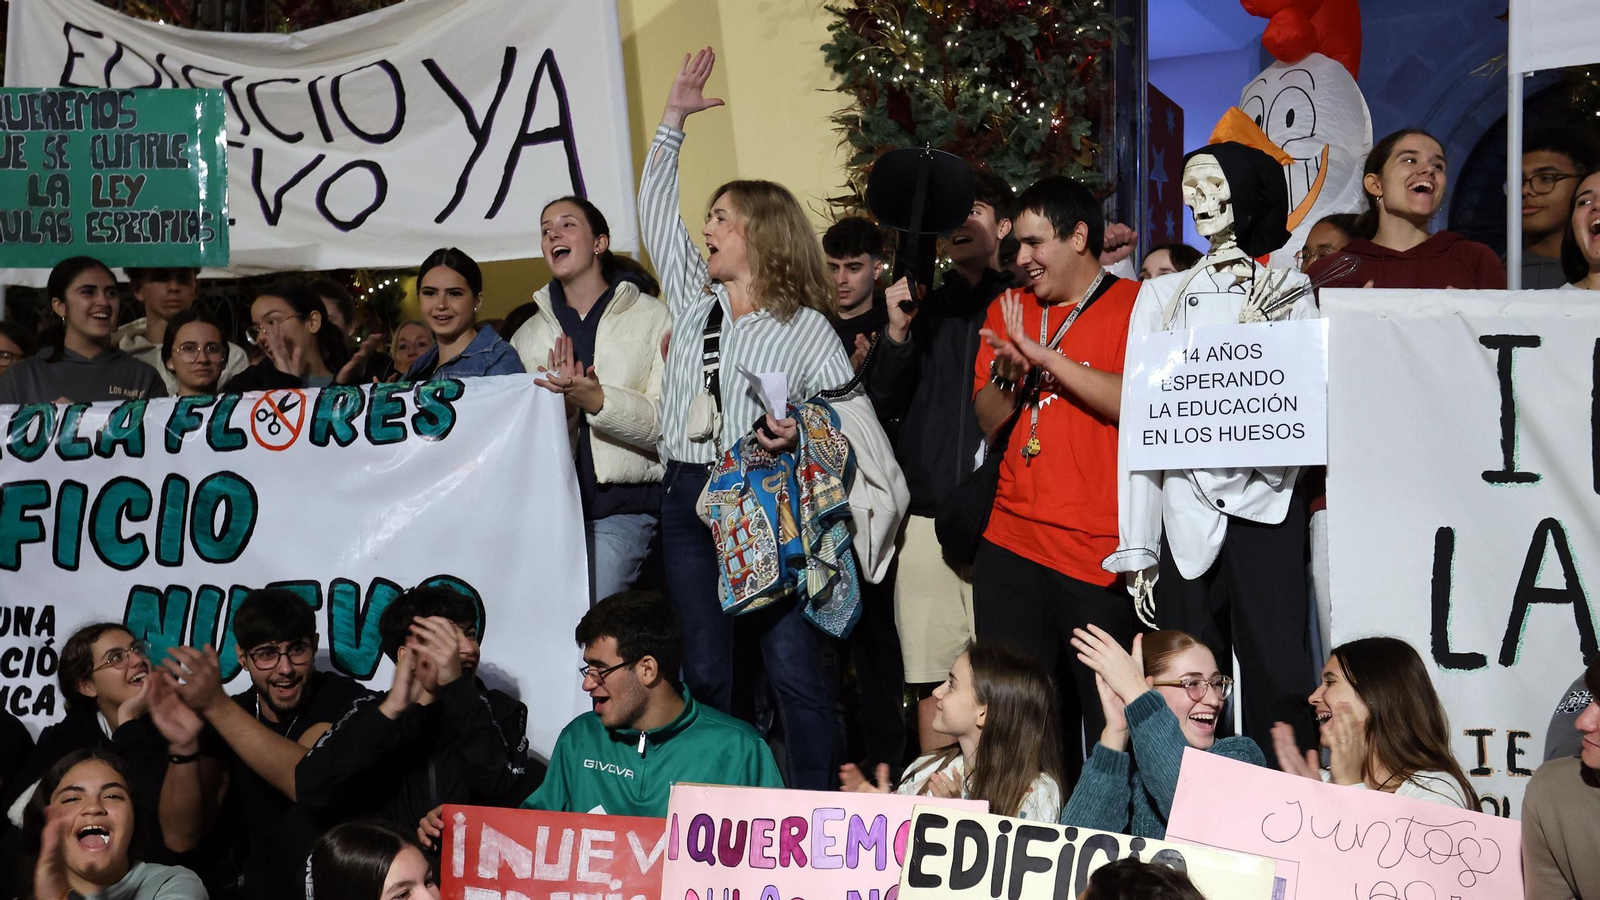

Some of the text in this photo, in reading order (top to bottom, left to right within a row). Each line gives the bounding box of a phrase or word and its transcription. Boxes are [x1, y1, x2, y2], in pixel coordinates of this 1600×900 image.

[42, 133, 72, 170] SE
[90, 132, 190, 170] CUMPLE
[420, 46, 588, 223] YA
[27, 173, 147, 209] LA LEY
[0, 209, 73, 244] ULAS
[1182, 342, 1263, 364] 14 AÑOS
[1161, 369, 1285, 392] ESPERANDO
[1149, 393, 1298, 419] LA EDUCACIÓN
[0, 400, 149, 463] OLA
[1143, 422, 1305, 446] EN LOS HUESOS
